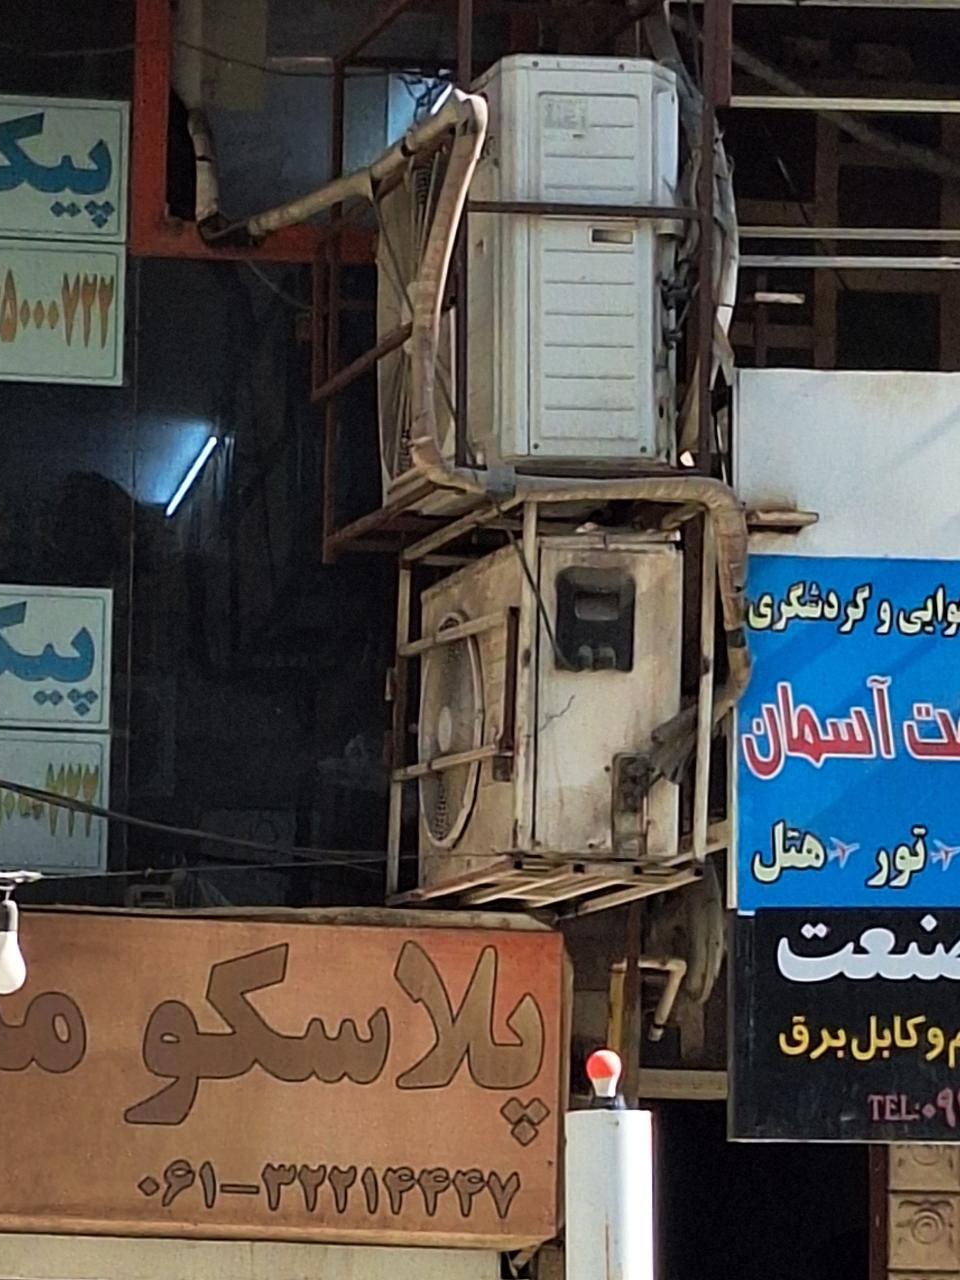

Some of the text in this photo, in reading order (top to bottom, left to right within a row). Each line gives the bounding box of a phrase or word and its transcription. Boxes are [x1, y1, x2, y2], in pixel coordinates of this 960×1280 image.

[742, 675, 896, 780] آسمان
[752, 818, 928, 888] تور هتل
[124, 940, 549, 1146] پلاسکو
[779, 1016, 846, 1060] برق
[851, 1015, 926, 1061] کابل
